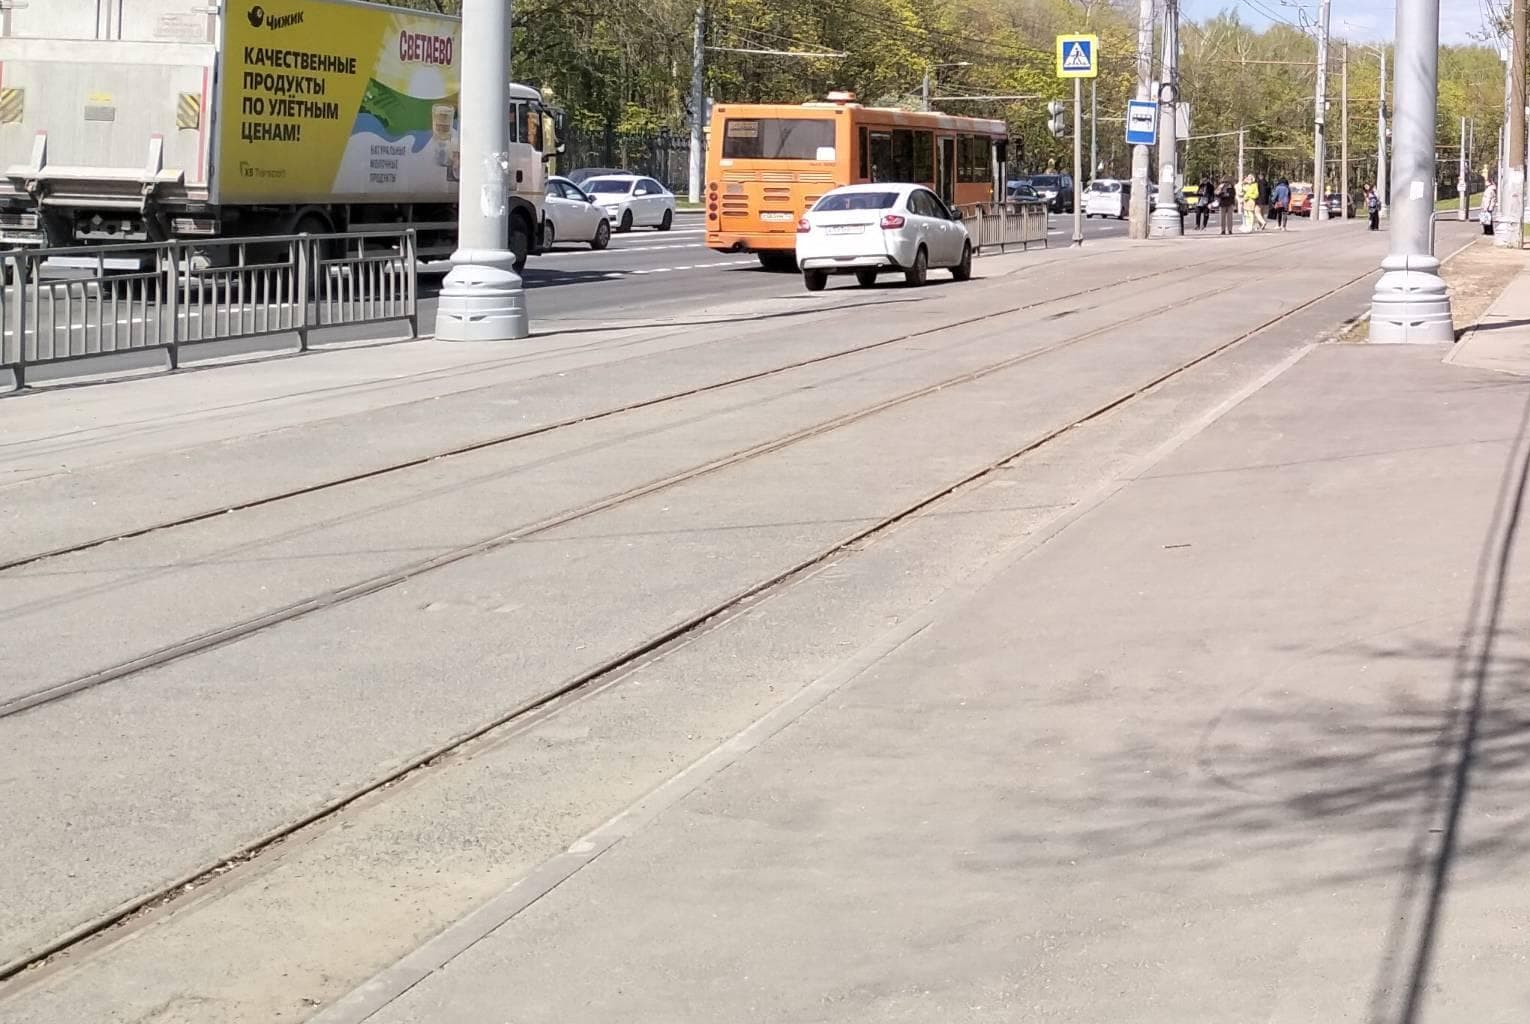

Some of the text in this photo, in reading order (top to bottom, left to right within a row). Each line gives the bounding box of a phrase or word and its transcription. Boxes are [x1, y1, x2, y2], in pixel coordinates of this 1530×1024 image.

[244, 47, 356, 74] КАЧЕСТВЕННЫЕ
[399, 30, 454, 66] СВЕТАЕВО
[243, 72, 326, 95] ПРОДУКТЫ
[243, 95, 338, 120] ПО УЛЁТНЫМ
[241, 122, 301, 144] ЦЕНАМ!
